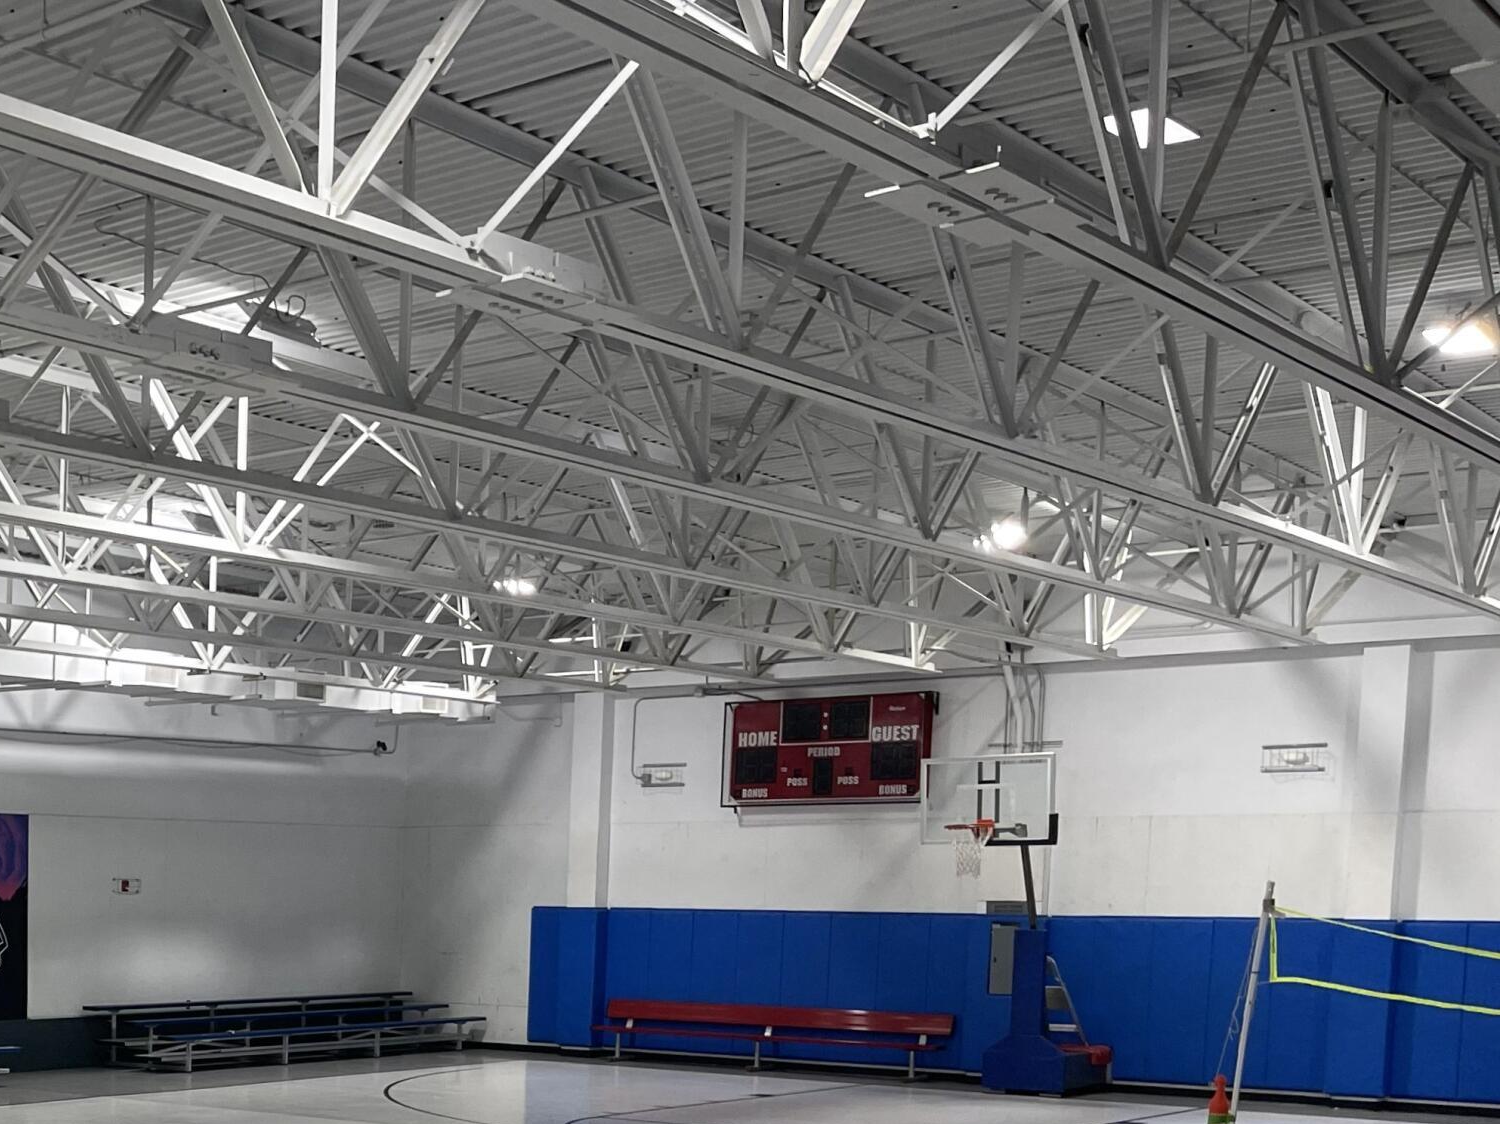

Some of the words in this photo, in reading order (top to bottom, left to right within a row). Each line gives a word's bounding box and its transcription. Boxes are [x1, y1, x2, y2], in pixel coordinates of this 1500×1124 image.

[871, 724, 920, 742] GUEST
[738, 731, 778, 748] HOME
[807, 747, 841, 757] PERIOD
[786, 777, 808, 787] POSS
[837, 776, 859, 785] POSS
[742, 788, 768, 799] BONUS
[879, 784, 907, 795] BONUS
